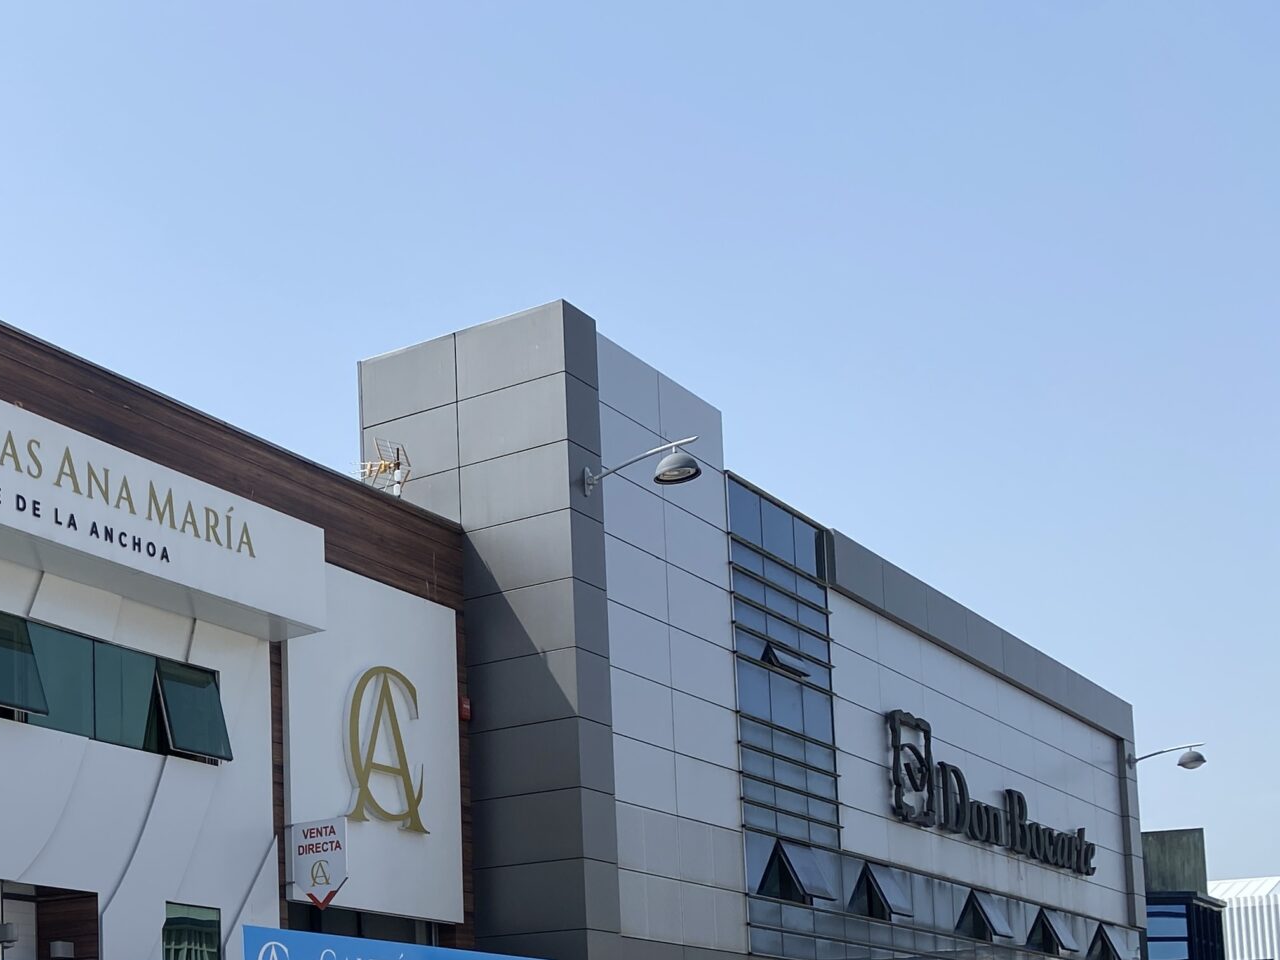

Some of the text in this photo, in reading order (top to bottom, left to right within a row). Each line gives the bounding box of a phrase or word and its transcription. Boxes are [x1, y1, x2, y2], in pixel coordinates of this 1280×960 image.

[15, 494, 41, 518] DE
[54, 507, 78, 531] LA
[89, 521, 171, 563] ANCHOA
[54, 446, 136, 515] ANA
[146, 480, 256, 558] MARÍA
[297, 840, 342, 855] DIRECTA
[302, 825, 336, 839] VENTA
[937, 761, 1097, 876] Don Bocarte
